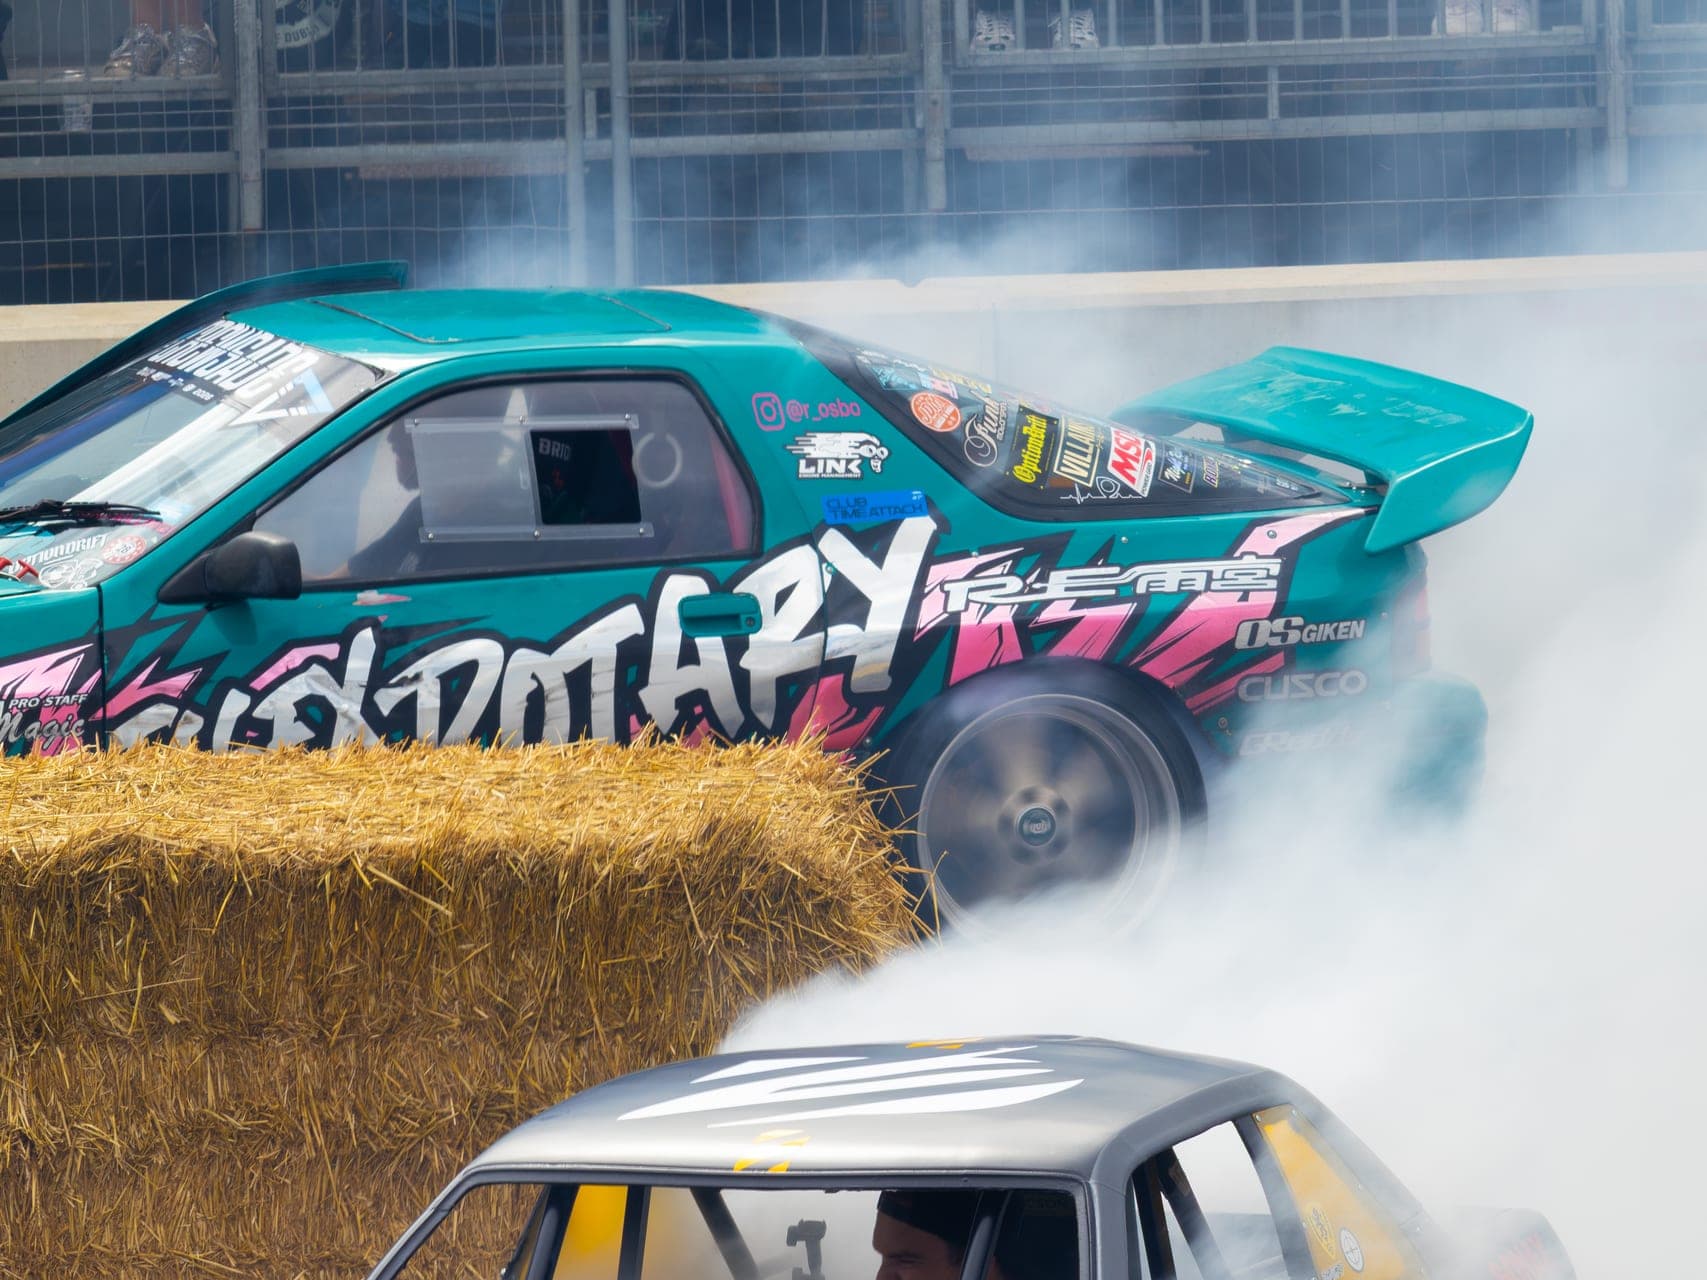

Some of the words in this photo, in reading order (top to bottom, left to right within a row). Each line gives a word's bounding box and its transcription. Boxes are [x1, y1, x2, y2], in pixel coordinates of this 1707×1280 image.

[786, 398, 861, 422] @r_osbo
[799, 458, 862, 474] LINK
[1235, 616, 1304, 650] OS
[1302, 620, 1366, 643] GIKEN
[1238, 670, 1368, 702] CUSCO
[8, 697, 41, 709] PRO
[44, 694, 89, 707] STAFF
[0, 711, 85, 750] Magic
